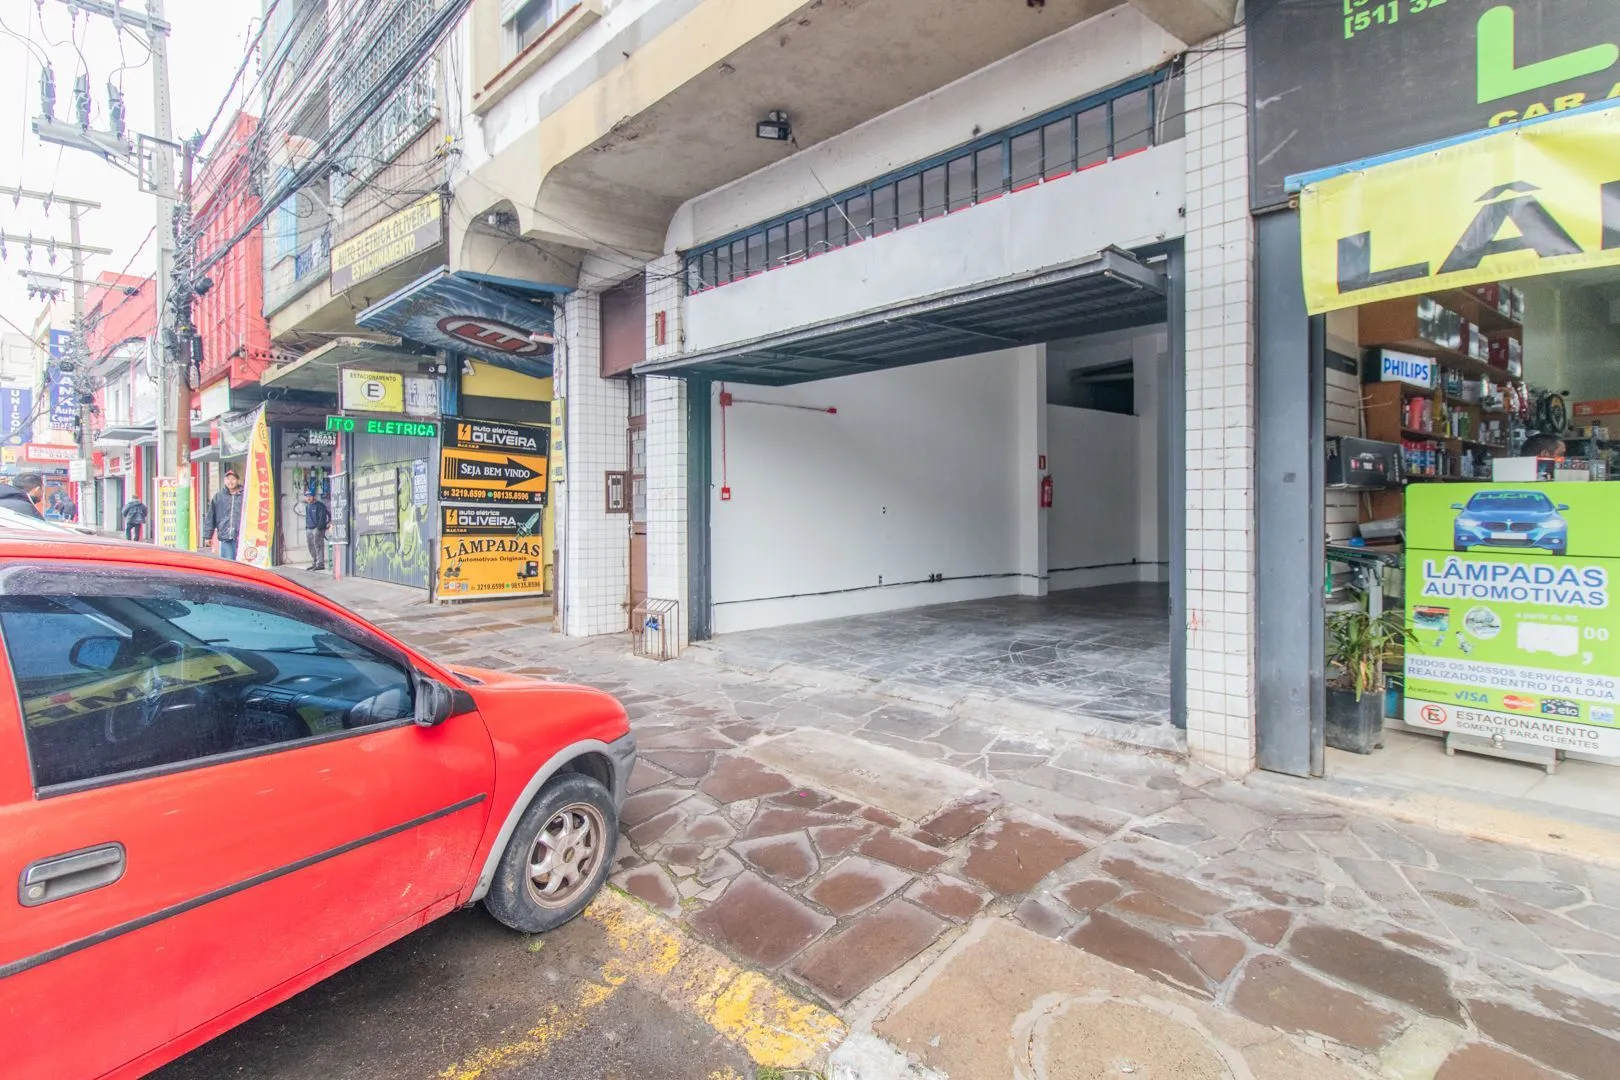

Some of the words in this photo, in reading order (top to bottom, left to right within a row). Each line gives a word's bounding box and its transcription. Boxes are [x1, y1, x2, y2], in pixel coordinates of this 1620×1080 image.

[393, 202, 432, 237] OLIVEIRA
[1337, 178, 1620, 295] LÂ
[350, 372, 397, 382] ESTACIONAMENTO
[1383, 357, 1429, 381] PHILIPS
[367, 383, 380, 398] E
[367, 420, 435, 437] ELETRICA
[472, 425, 491, 433] auto
[492, 427, 519, 436] elétrica
[472, 432, 537, 448] OLIVEIRA
[461, 463, 481, 476] SEJA
[484, 464, 502, 477] BEM
[504, 468, 531, 479] VINDO
[458, 516, 517, 526] OLIVEIRA
[476, 508, 500, 516] elétrica
[444, 538, 541, 560] LÂMPADAS
[1426, 557, 1605, 588] LÂMPADAS
[1424, 581, 1605, 607] AUTOMOTIVAS
[1407, 666, 1487, 684] REALIZADOS
[1490, 675, 1548, 692] DENTRO
[1551, 684, 1572, 694] DA
[1575, 687, 1616, 700] LOJA
[1409, 658, 1446, 669] TODOS
[1448, 662, 1465, 671] OS
[1467, 664, 1517, 677] NOSSOS
[1586, 677, 1615, 689] SÃO
[1455, 690, 1489, 704] VISA
[1455, 710, 1600, 740] ESTACIONAMENTO
[1455, 720, 1508, 736] SOMENTE
[1509, 728, 1540, 740] PARA
[1542, 733, 1600, 750] CLIENTES
